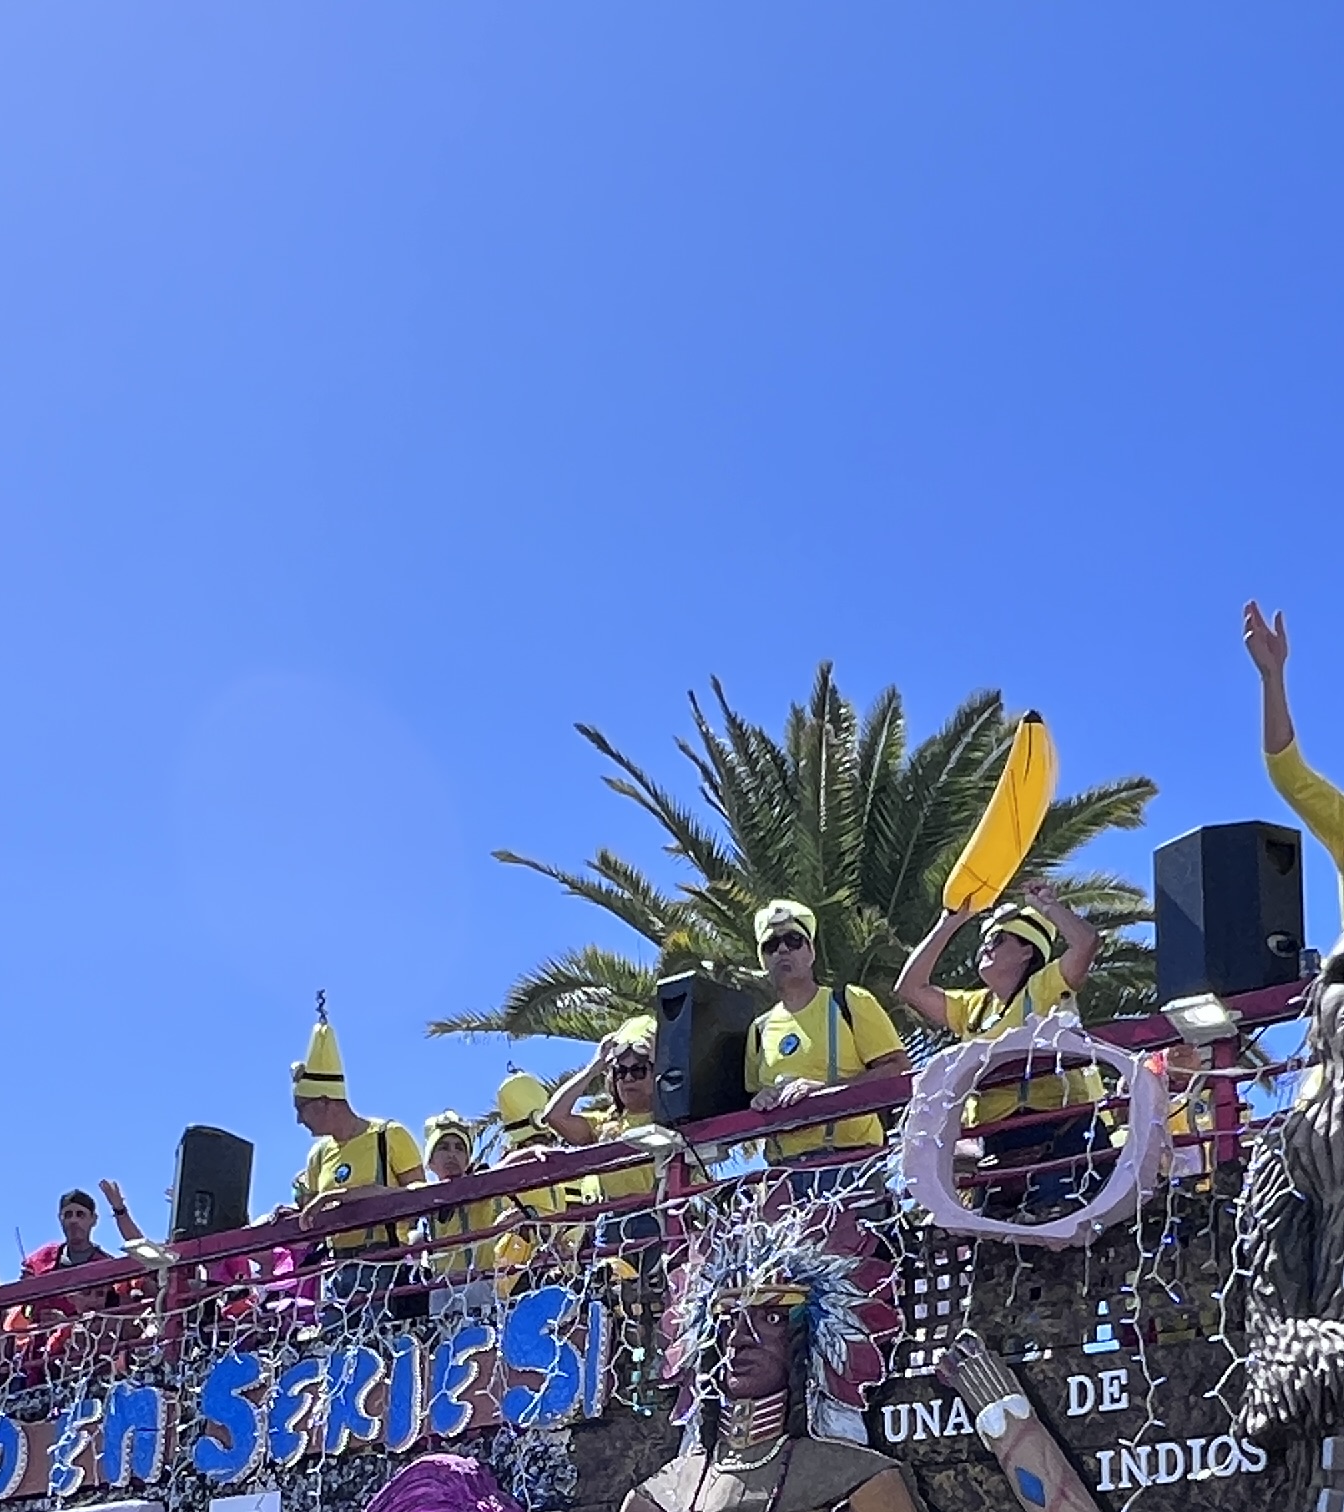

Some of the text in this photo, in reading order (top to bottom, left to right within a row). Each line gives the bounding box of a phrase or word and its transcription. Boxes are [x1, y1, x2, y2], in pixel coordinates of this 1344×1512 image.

[881, 1368, 1129, 1442] UNA DE
[1096, 1435, 1267, 1493] INDIOS
